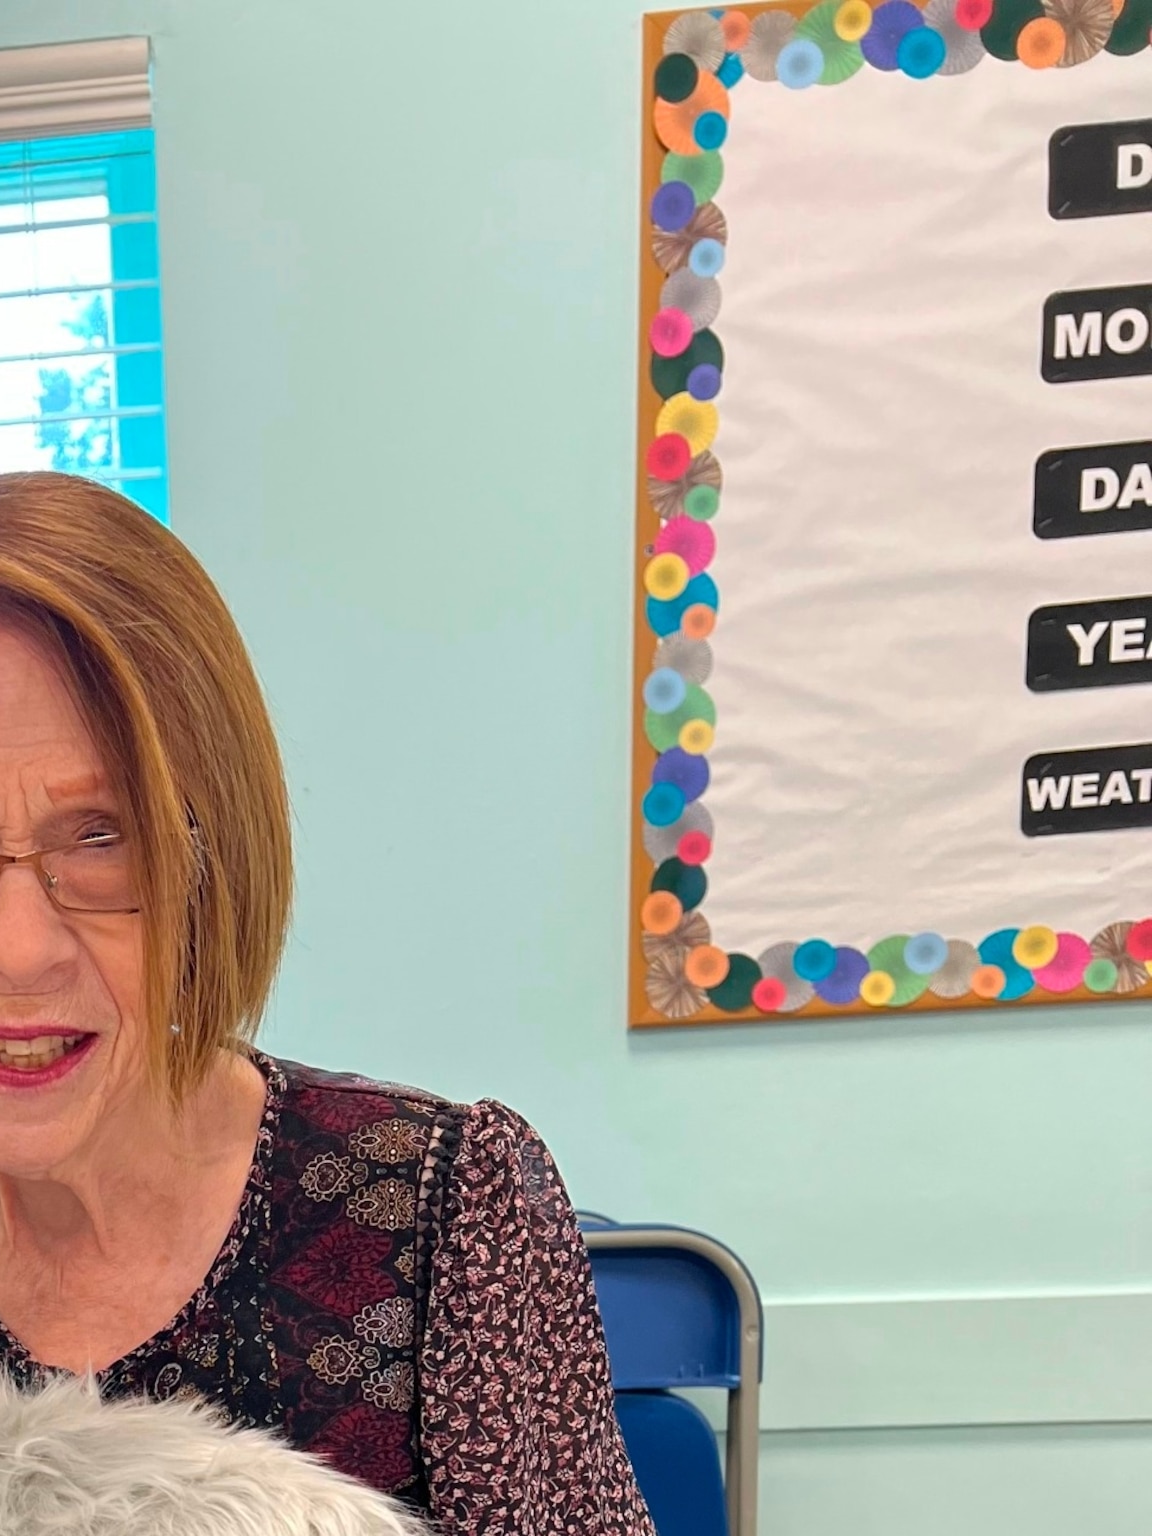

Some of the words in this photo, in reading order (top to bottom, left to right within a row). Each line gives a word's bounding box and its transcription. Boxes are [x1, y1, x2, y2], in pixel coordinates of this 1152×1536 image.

[1117, 143, 1152, 189] D
[1054, 308, 1152, 359] MO
[1080, 463, 1152, 512] DA
[1066, 618, 1152, 666] YE
[1027, 768, 1152, 812] WEAT
